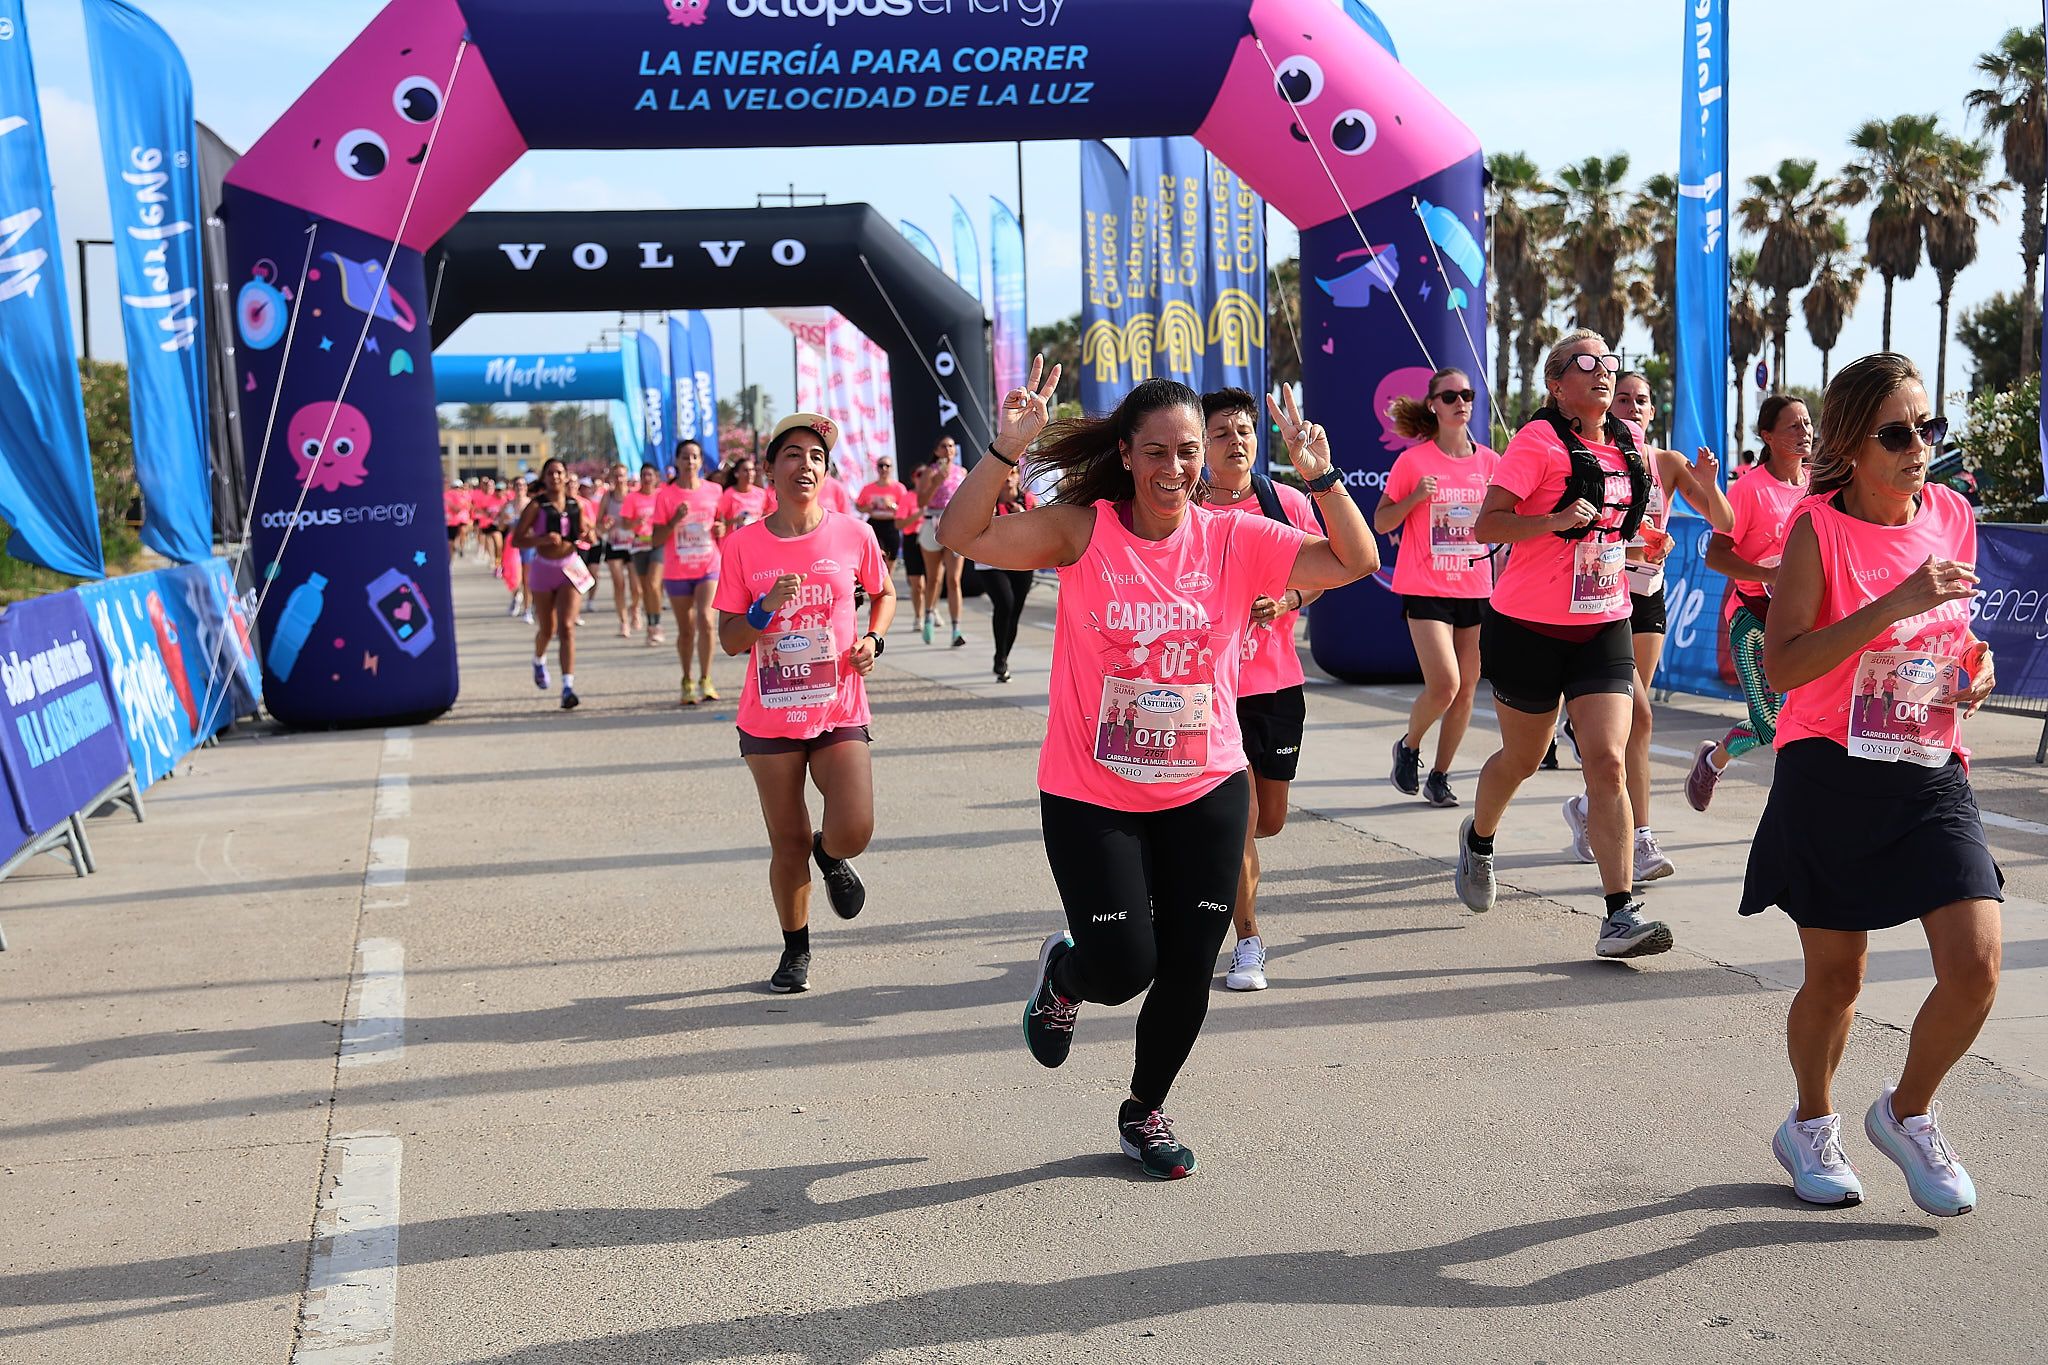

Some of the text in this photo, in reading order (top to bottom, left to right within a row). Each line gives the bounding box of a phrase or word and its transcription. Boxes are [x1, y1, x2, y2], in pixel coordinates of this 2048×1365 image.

[639, 43, 1089, 76] LA ENERGÍA PARA CORRER
[634, 82, 1095, 111] A LA VELOCIDAD DE LA LUZ
[499, 238, 807, 270] VOLVO
[261, 503, 417, 531] octopus energy
[1449, 527, 1470, 535] 016
[752, 569, 784, 582] OYSHO
[1101, 571, 1146, 585] OYSHO
[1599, 574, 1618, 587] 016
[1106, 601, 1212, 631] CARRERA
[781, 664, 812, 679] 016
[1114, 687, 1137, 697] SUMA
[768, 696, 793, 704] OYSHO
[1140, 696, 1182, 708] ASTURIANA
[786, 711, 808, 723] 2026
[1895, 702, 1928, 724] 016
[1135, 729, 1177, 748] 016
[1861, 729, 1890, 740] CARRERA
[1891, 732, 1900, 740] DE
[1144, 750, 1165, 758] 2767
[1861, 743, 1901, 755] OYSHO
[1106, 753, 1132, 764] CARRERA
[1198, 901, 1228, 912] PRO
[1092, 911, 1128, 923] NIKE
